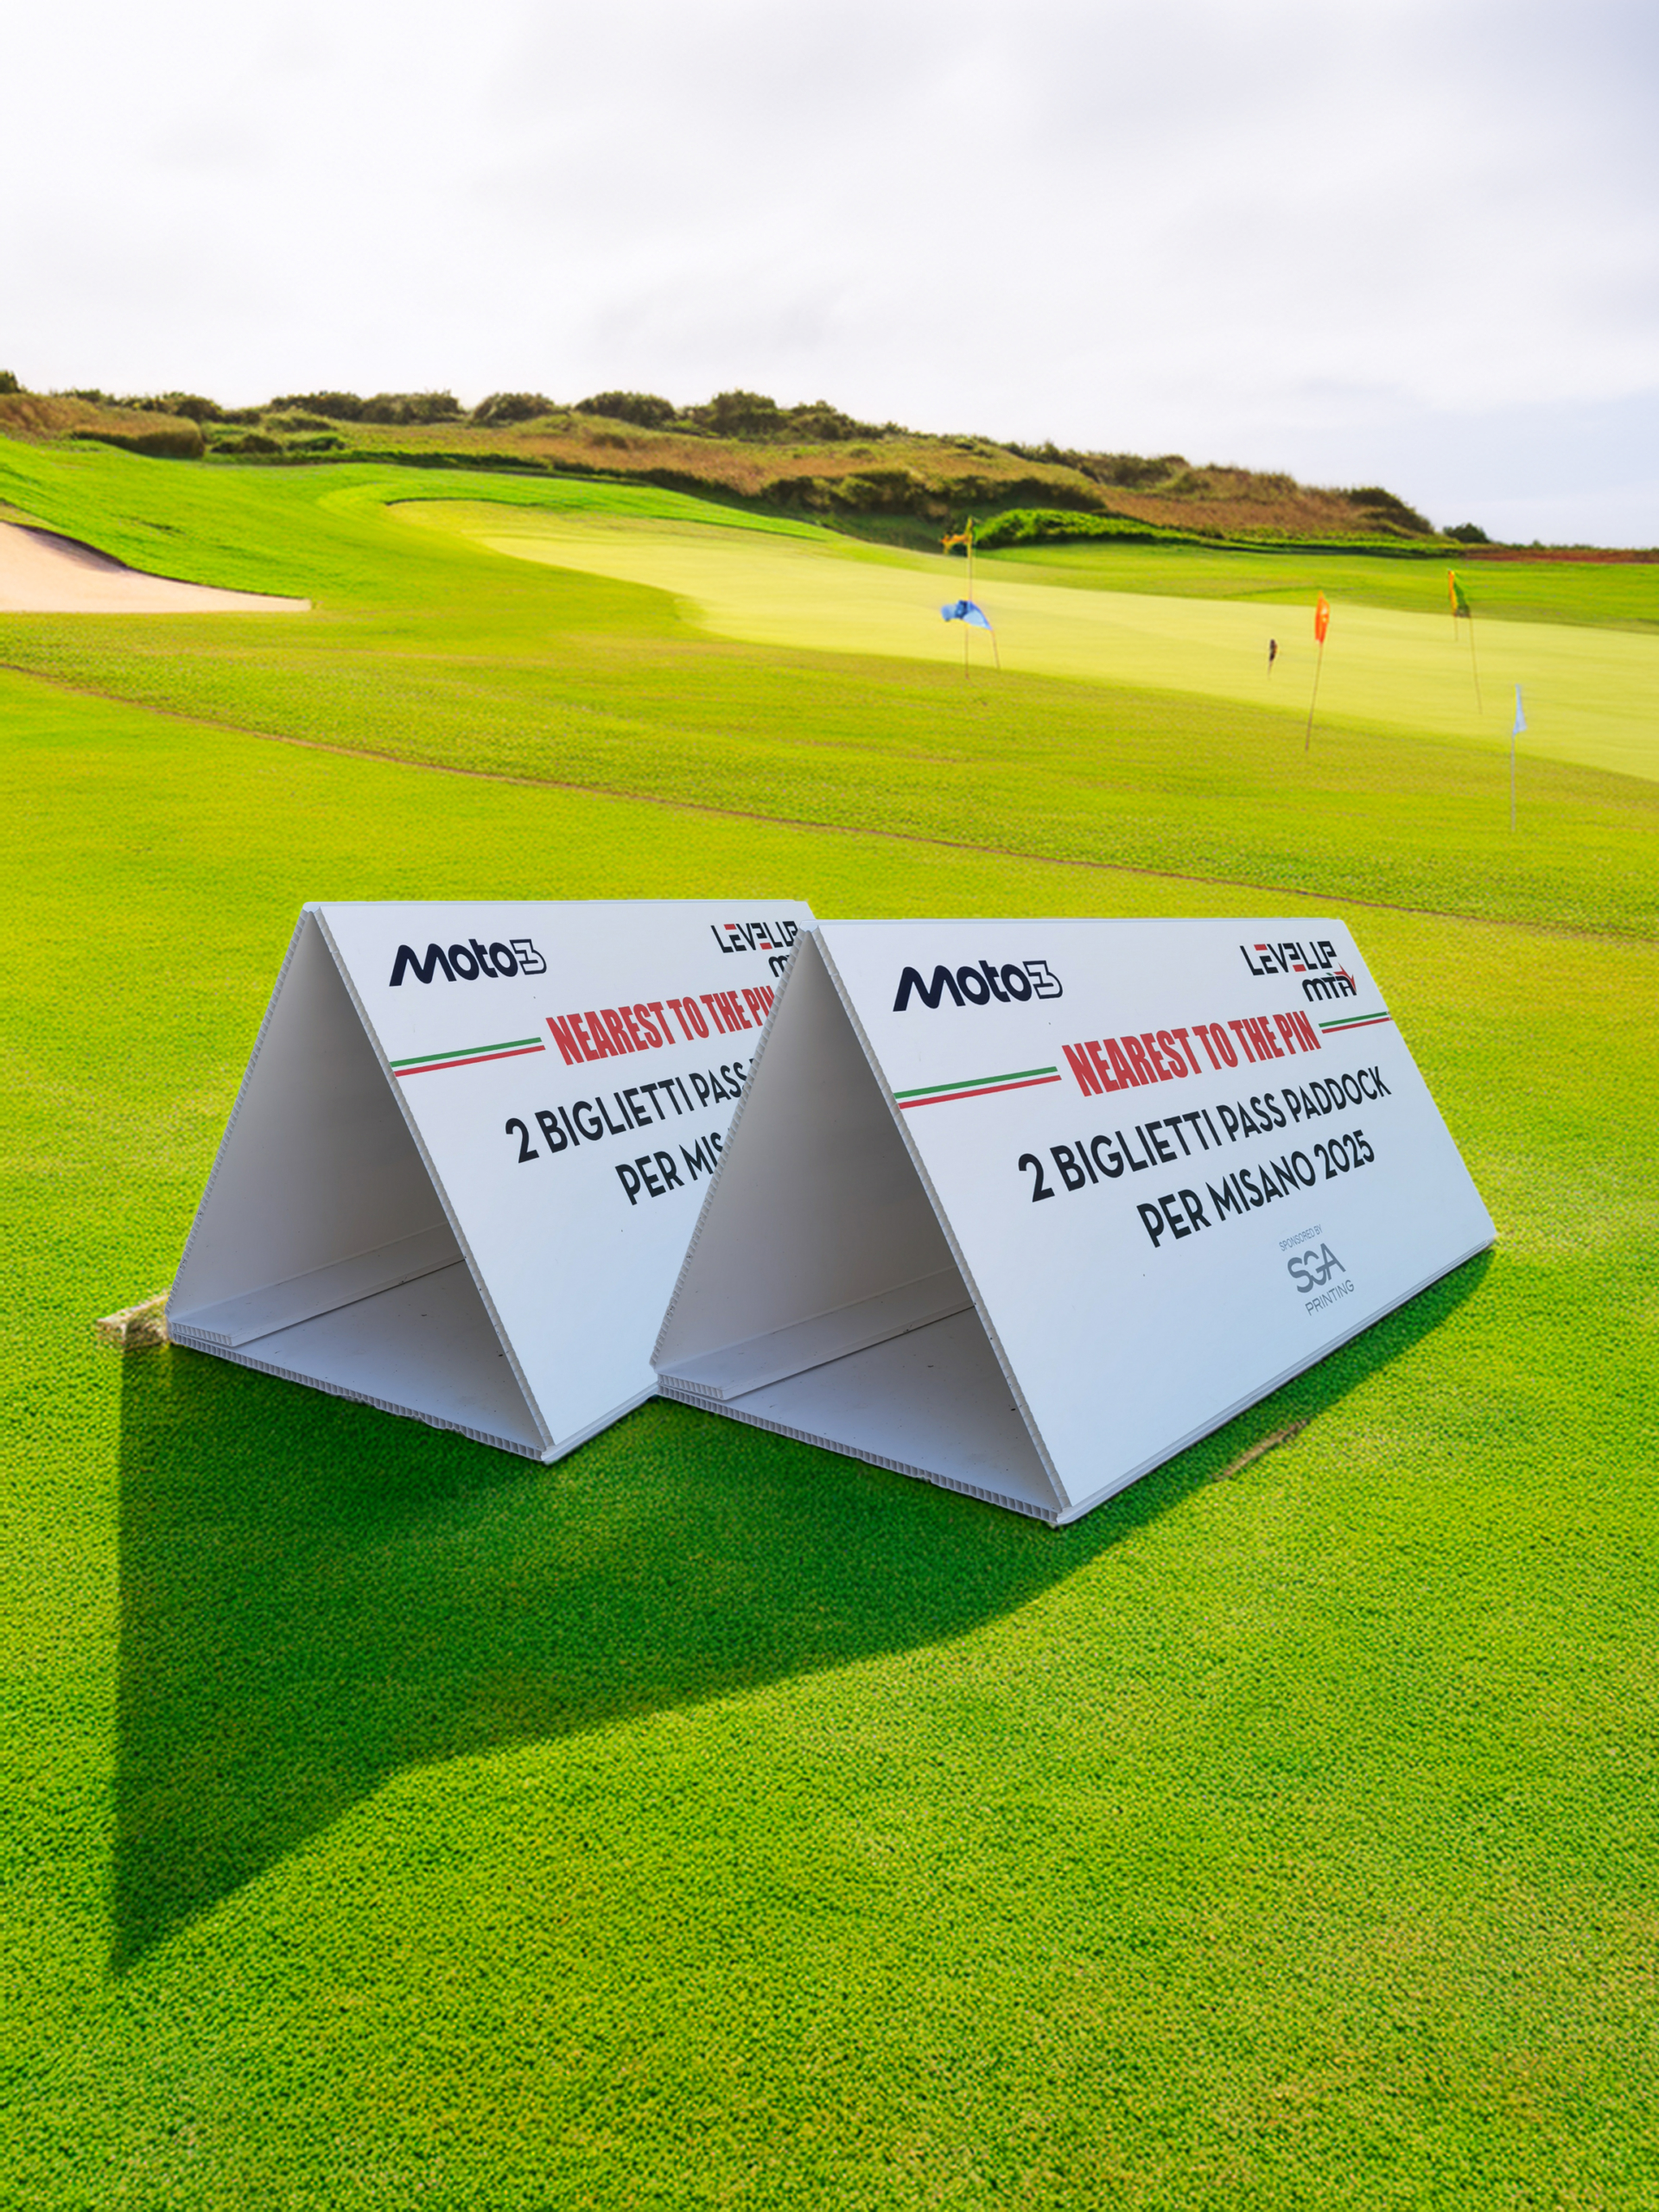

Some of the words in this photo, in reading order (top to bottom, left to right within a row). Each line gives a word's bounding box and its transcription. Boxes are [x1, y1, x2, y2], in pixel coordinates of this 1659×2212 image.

[545, 1001, 676, 1066] NEAREST
[666, 996, 709, 1041] TO
[699, 990, 753, 1034] THE
[1062, 1027, 1202, 1097] NEAREST
[1192, 1022, 1239, 1071] TO
[1227, 1015, 1286, 1064] THE
[1272, 1010, 1322, 1055] PIN
[505, 1118, 540, 1164] 2
[535, 1077, 691, 1154] BIGLIETTI
[689, 1061, 747, 1109] PASS
[1018, 1153, 1055, 1203] 2
[1050, 1109, 1223, 1192] BIGLIETTI
[1216, 1093, 1287, 1142] PASS
[1281, 1065, 1392, 1123] PADDOCK
[614, 1150, 685, 1206] PER
[1136, 1189, 1212, 1249] PER
[1205, 1150, 1317, 1222] MISANO
[1313, 1129, 1376, 1180] 2025
[1279, 1228, 1316, 1252] SPONSORED
[1313, 1224, 1324, 1236] BY
[1287, 1243, 1346, 1294] SGA
[1305, 1279, 1355, 1316] PRINTING
